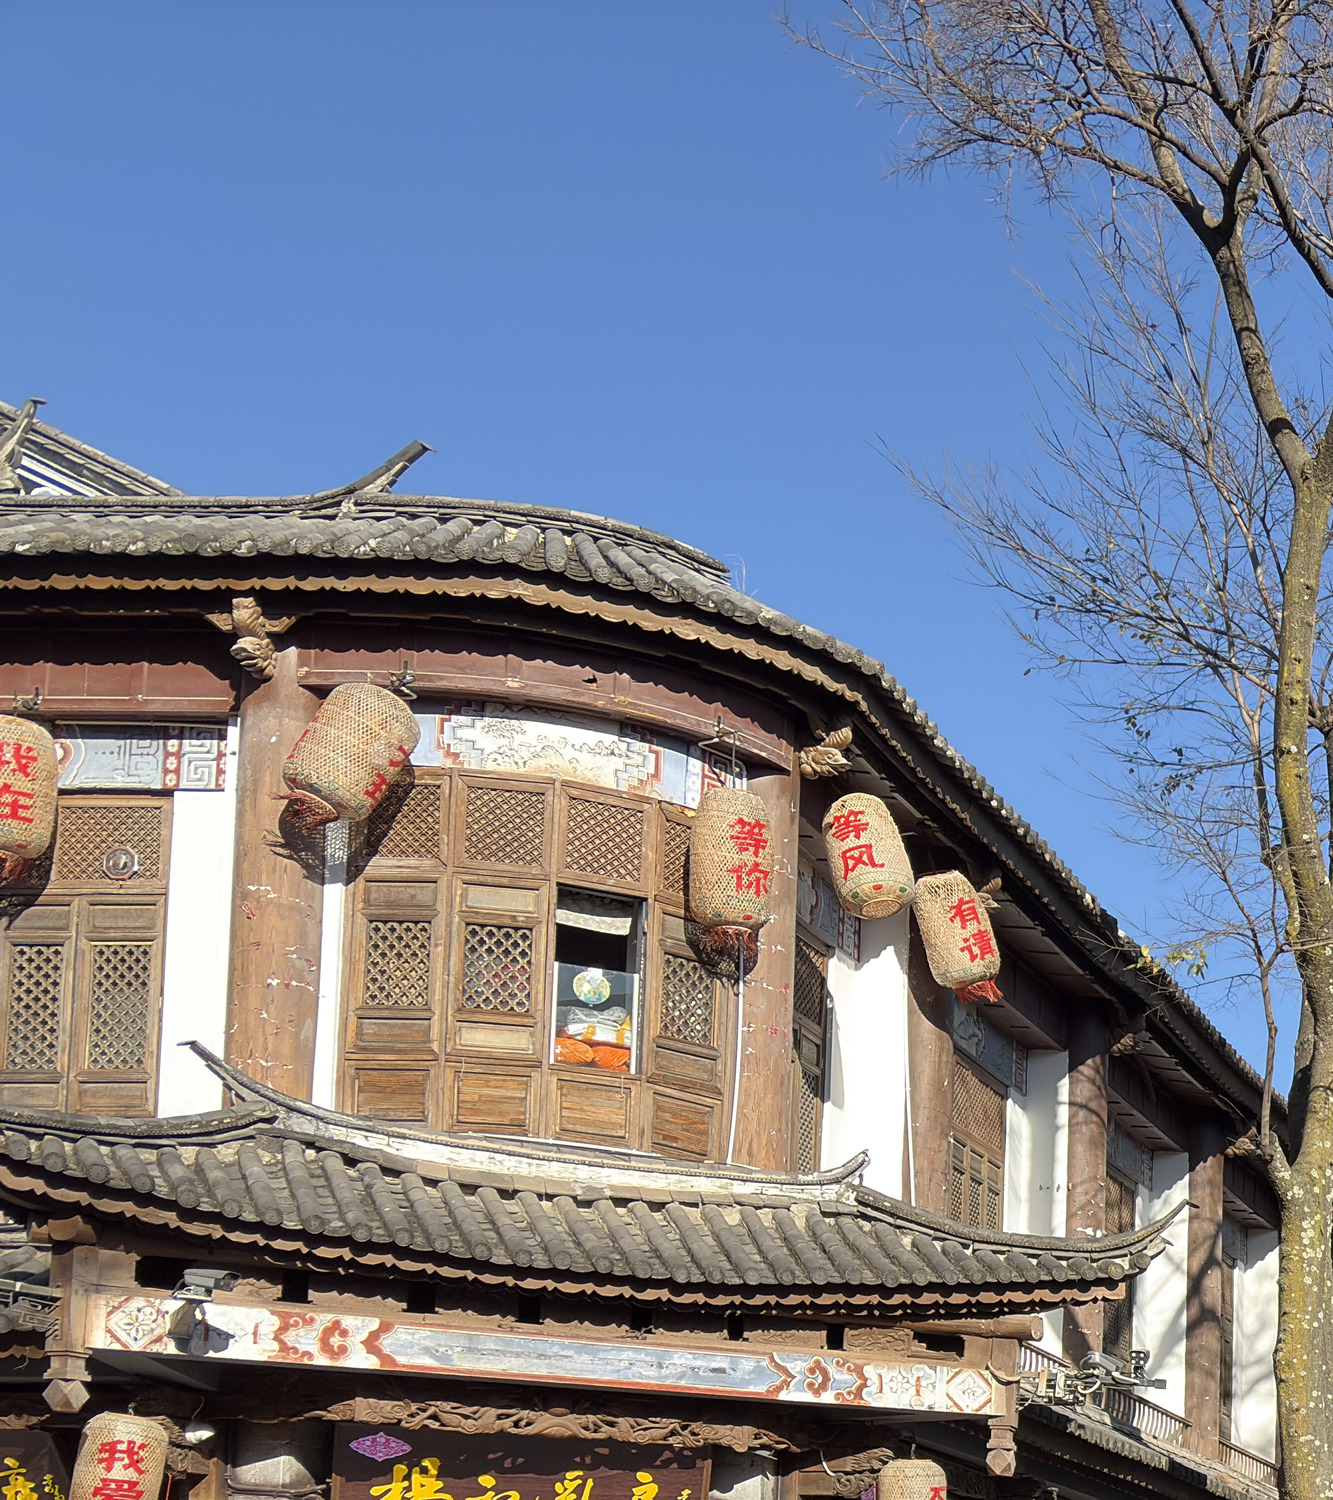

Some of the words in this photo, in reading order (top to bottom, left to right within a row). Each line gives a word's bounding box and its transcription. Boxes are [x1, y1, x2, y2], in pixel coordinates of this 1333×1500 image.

[727, 817, 769, 898] 等你
[831, 809, 885, 880] 等风
[949, 896, 996, 964] 有请
